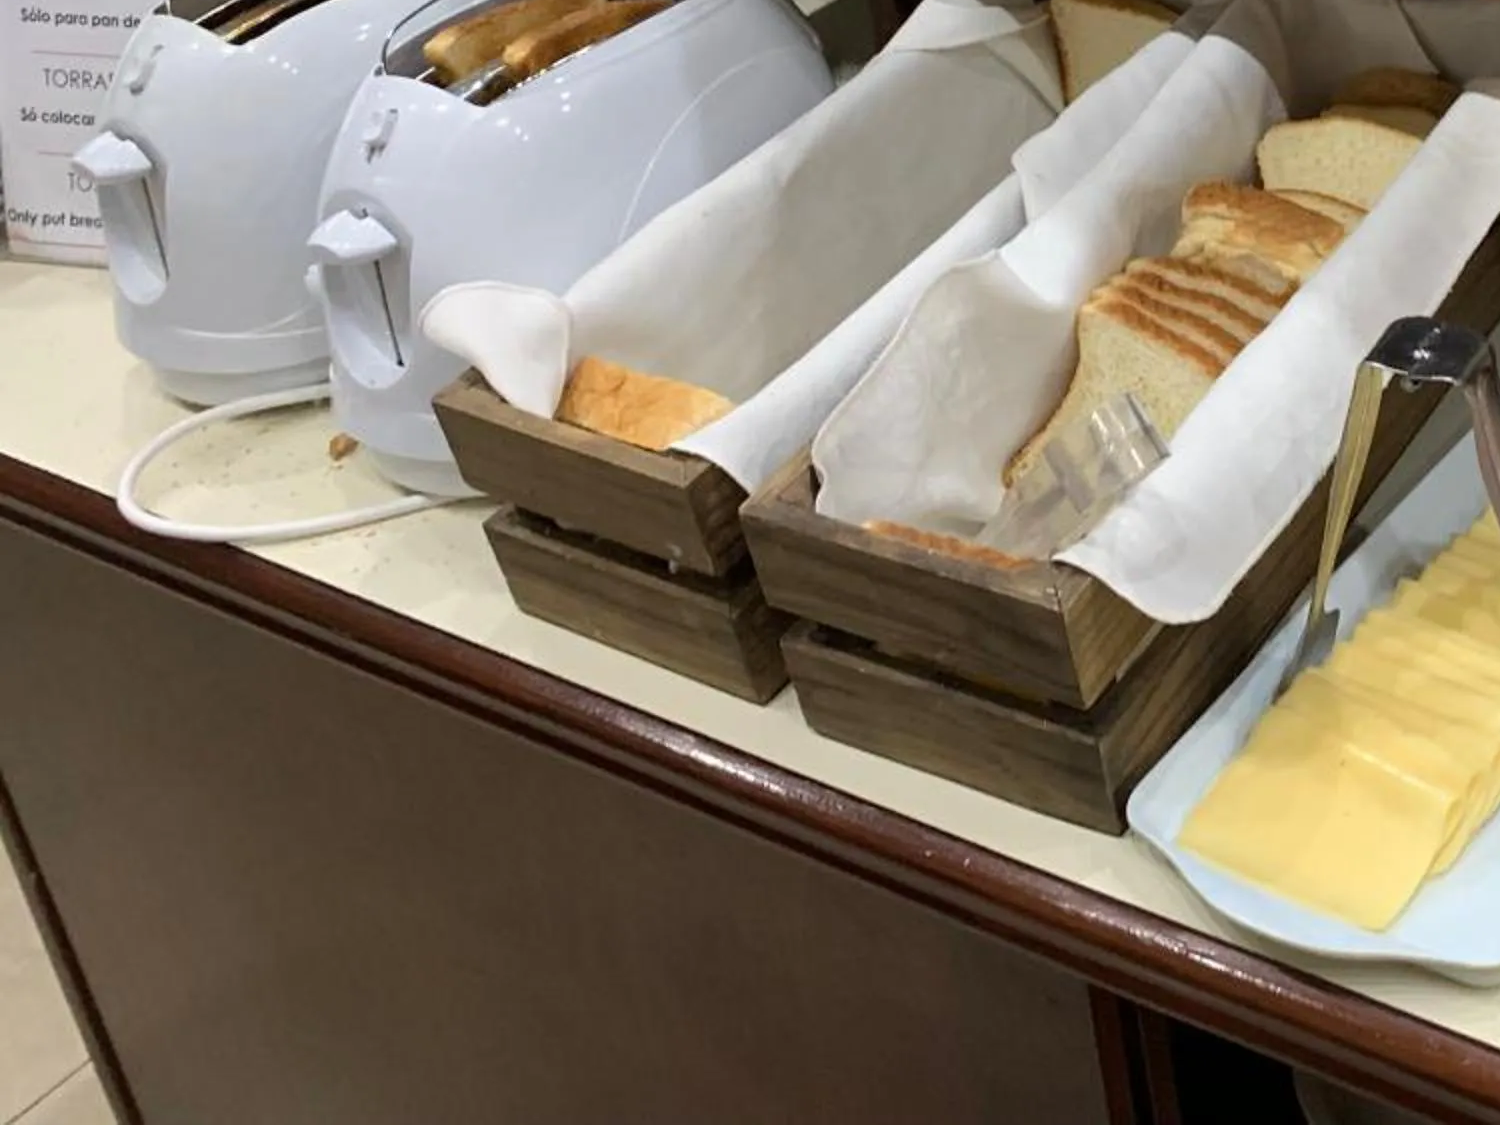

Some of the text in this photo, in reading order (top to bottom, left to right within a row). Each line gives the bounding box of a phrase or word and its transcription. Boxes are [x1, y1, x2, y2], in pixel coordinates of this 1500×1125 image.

[55, 12, 88, 25] para
[92, 14, 119, 27] pan
[123, 15, 141, 28] de
[8, 208, 37, 227] Only
[42, 212, 66, 226] put
